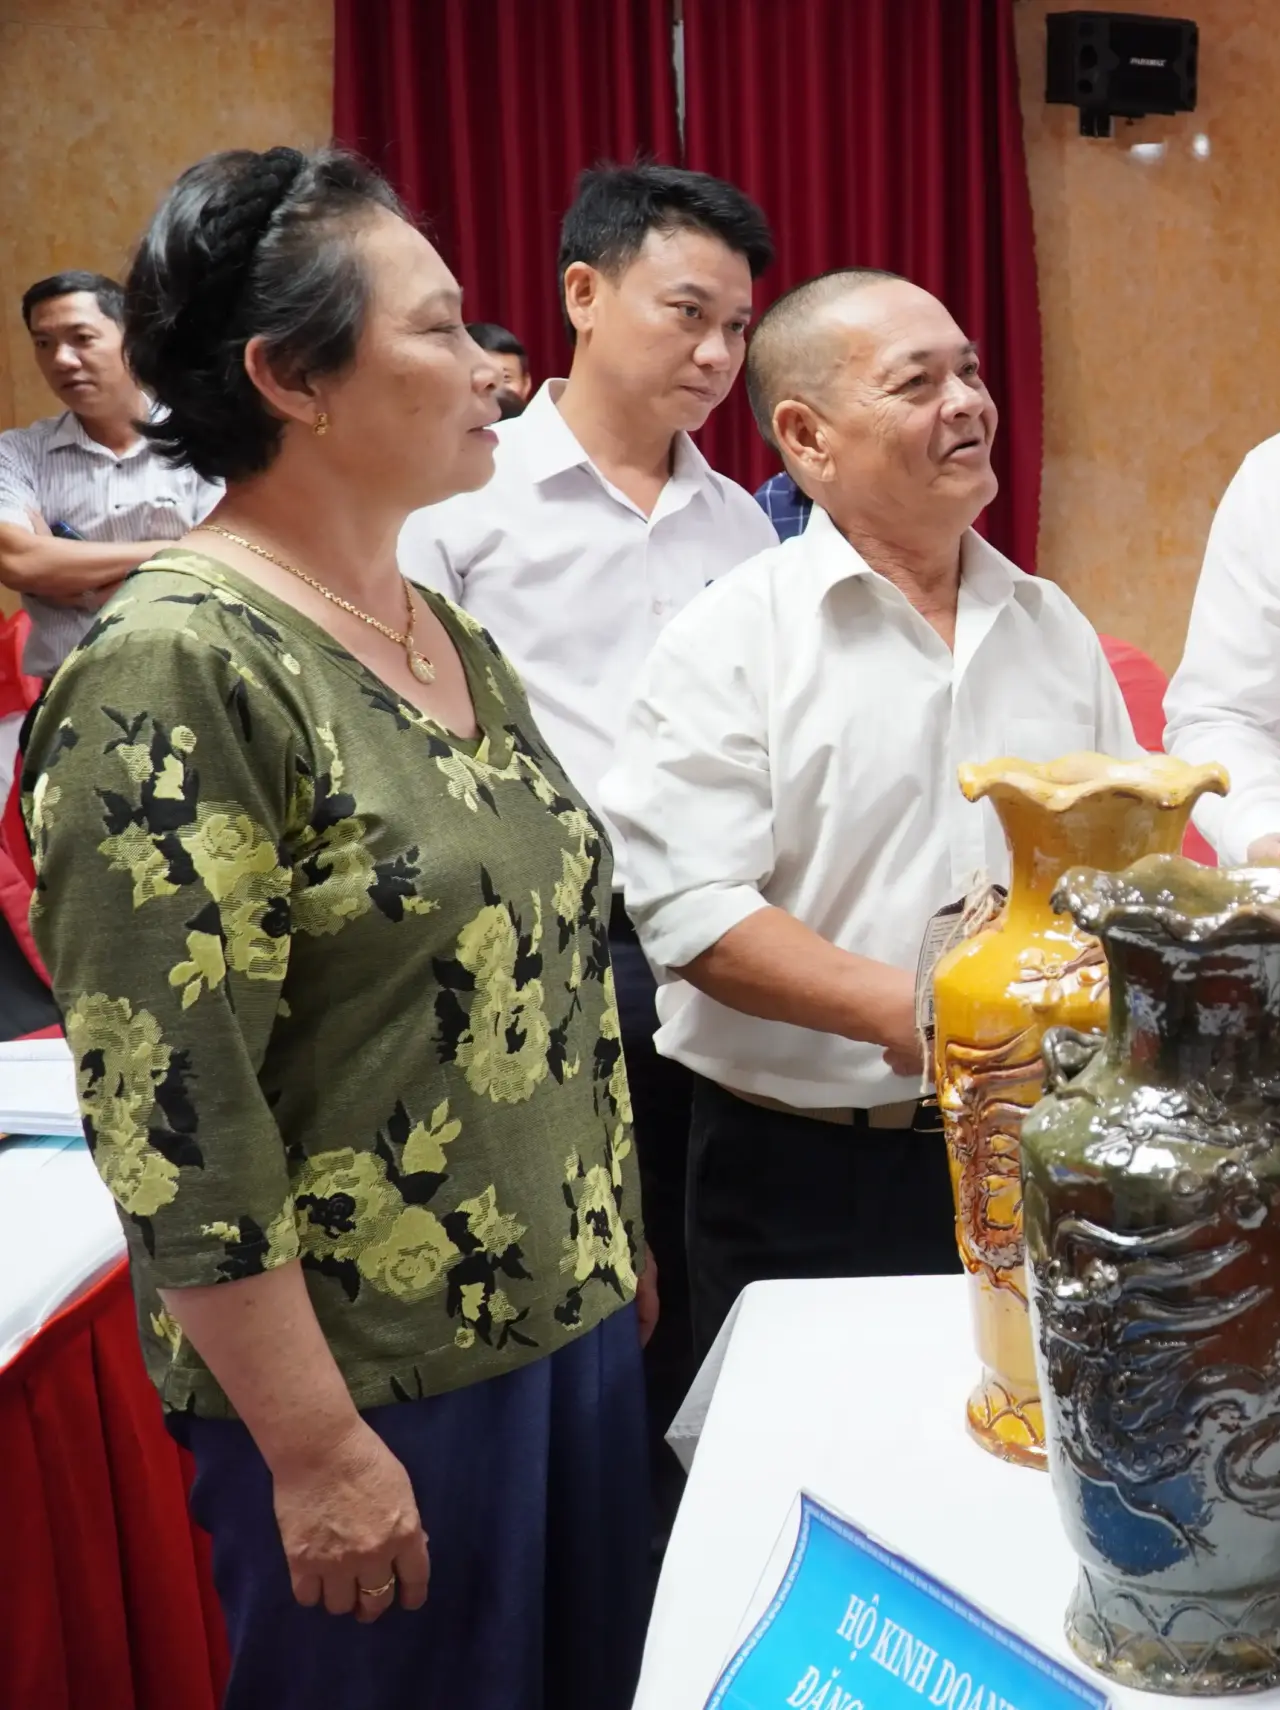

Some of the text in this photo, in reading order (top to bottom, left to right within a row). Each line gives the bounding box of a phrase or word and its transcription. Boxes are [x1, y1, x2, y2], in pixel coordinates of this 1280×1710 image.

[785, 1665, 865, 1710] ĐĂN
[836, 1593, 1019, 1710] HỘ KINH DOA
